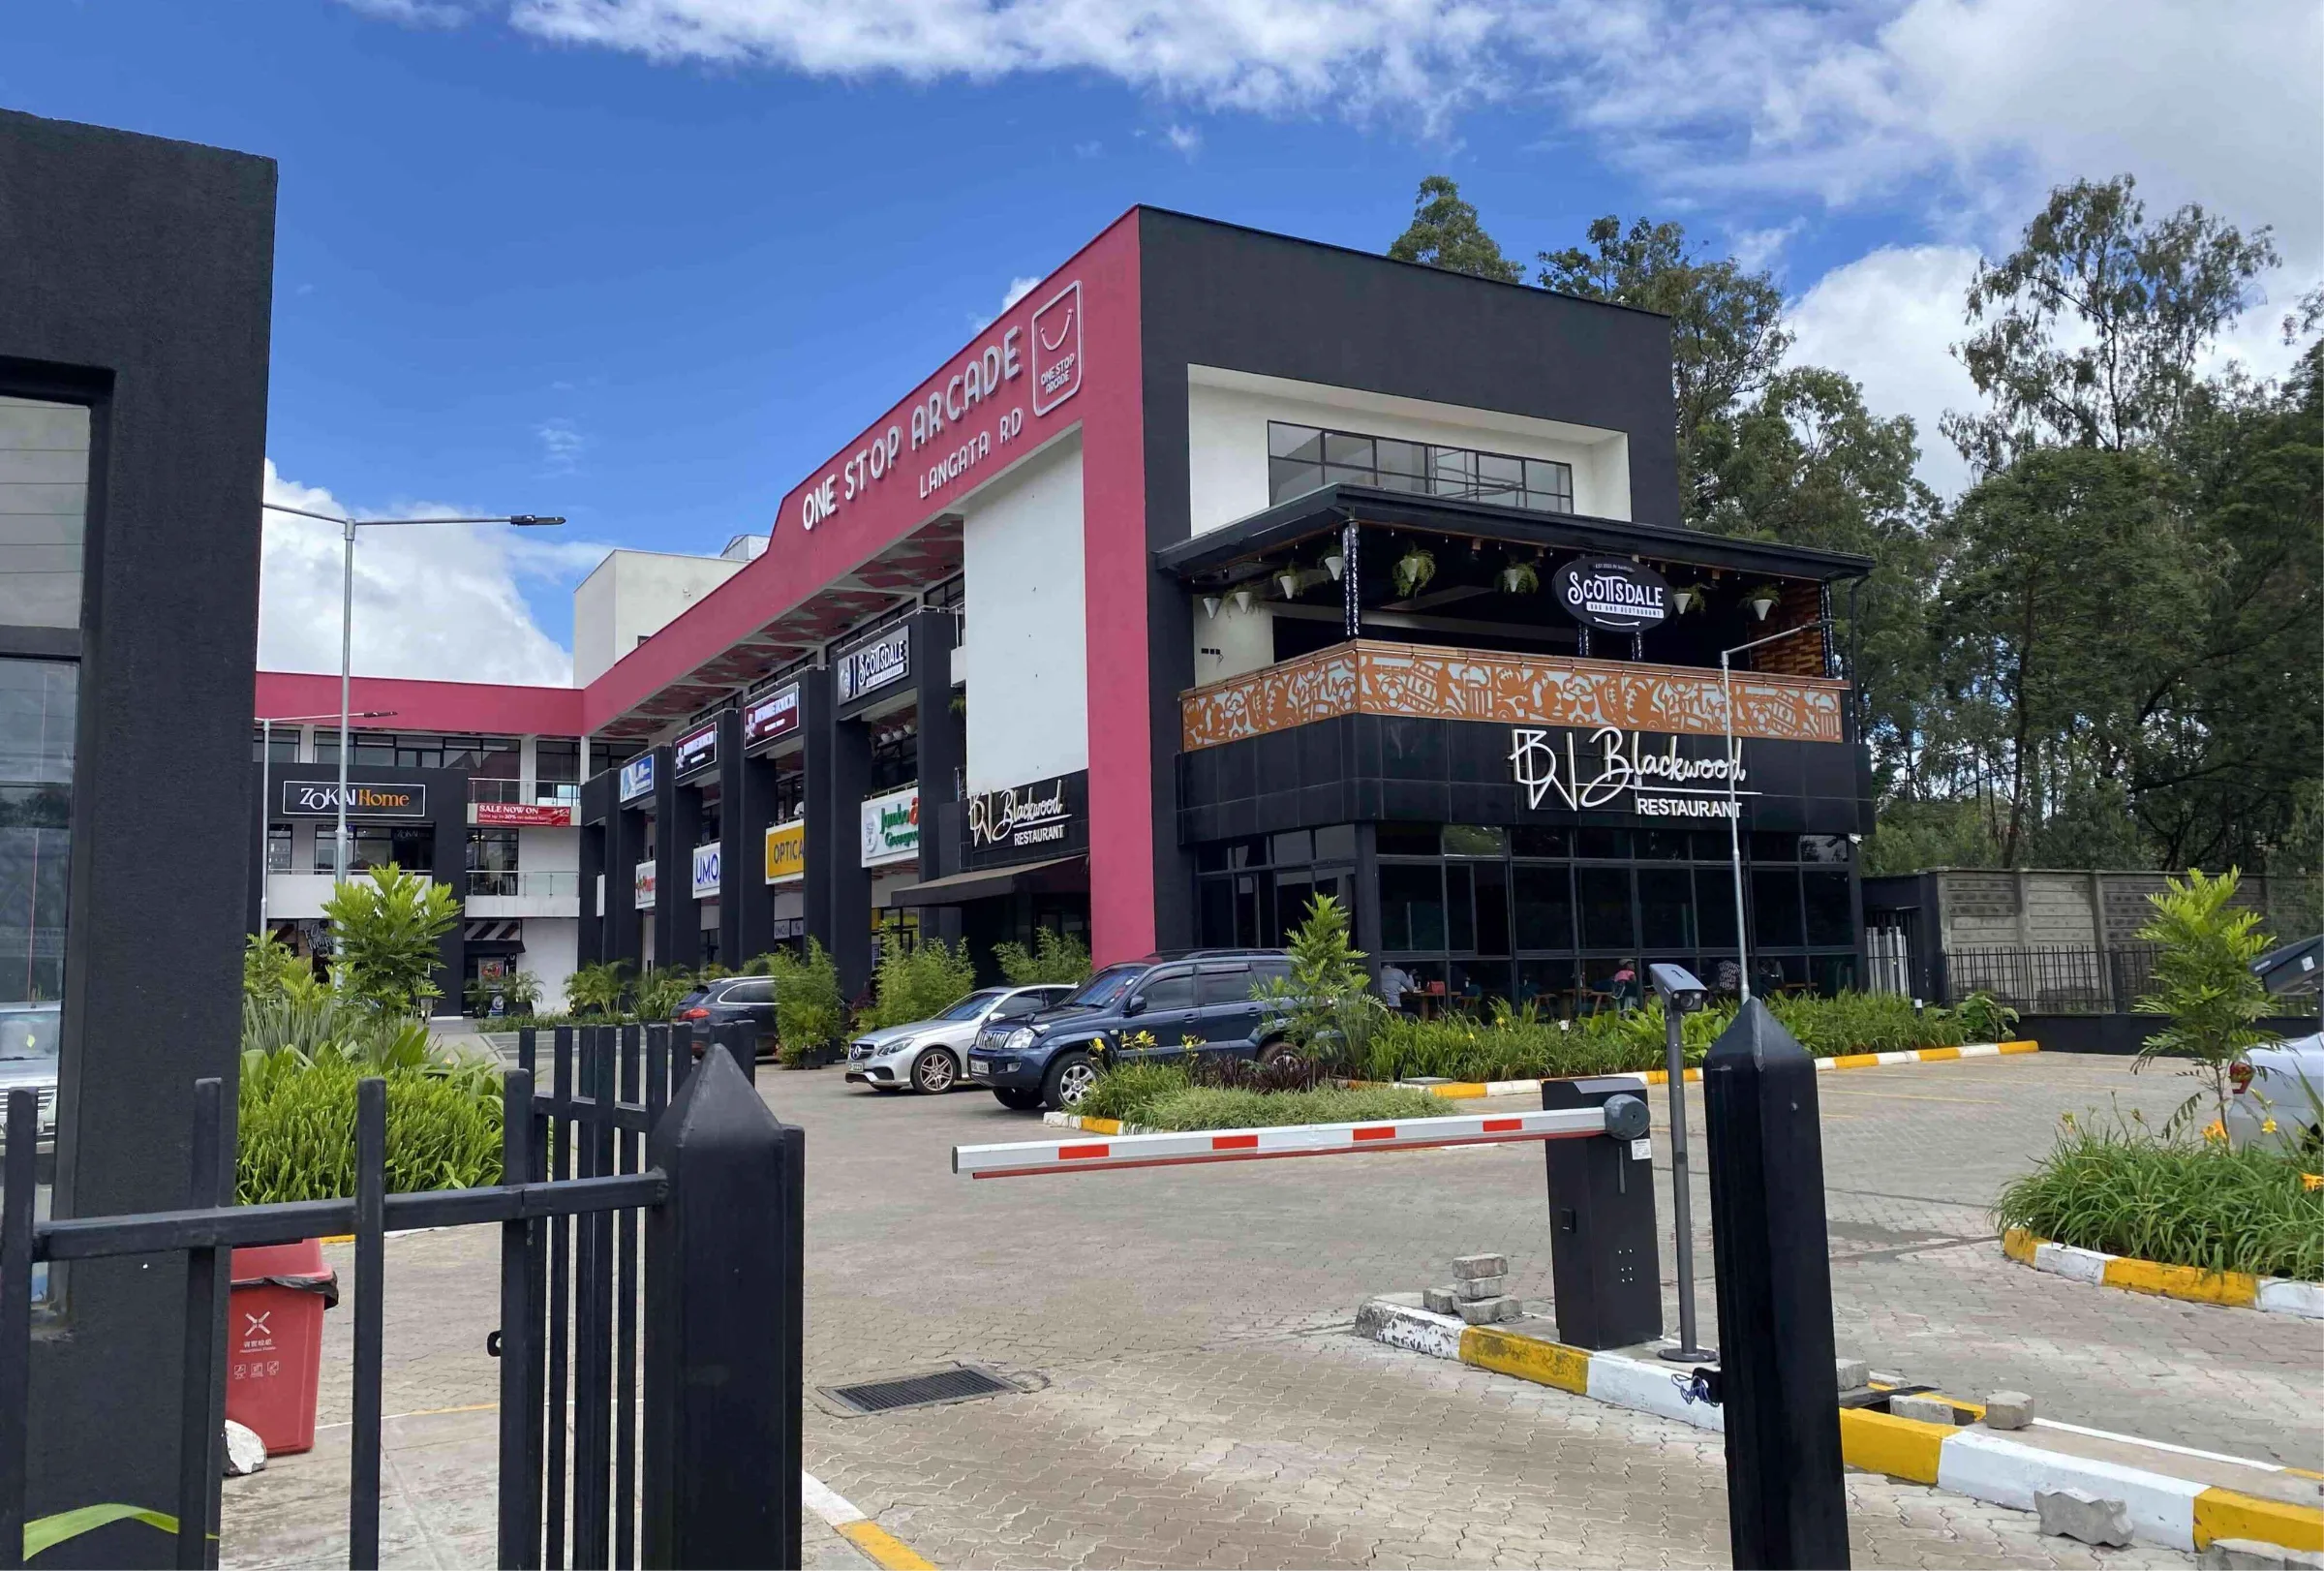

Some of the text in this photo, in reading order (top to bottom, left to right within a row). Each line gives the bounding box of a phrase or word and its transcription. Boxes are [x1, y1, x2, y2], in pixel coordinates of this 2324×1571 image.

[1041, 353, 1075, 385] ONE STOP
[1046, 369, 1070, 394] ARCADE
[802, 325, 1022, 531] ONE STOP ARCADE
[919, 408, 1024, 499] LANGATA RD
[1579, 726, 1747, 807] Blackwood
[358, 788, 410, 807] Home
[992, 779, 1064, 841] Blackwood
[1636, 797, 1743, 818] RESTAURANT
[1014, 824, 1065, 846] RESTAURANT
